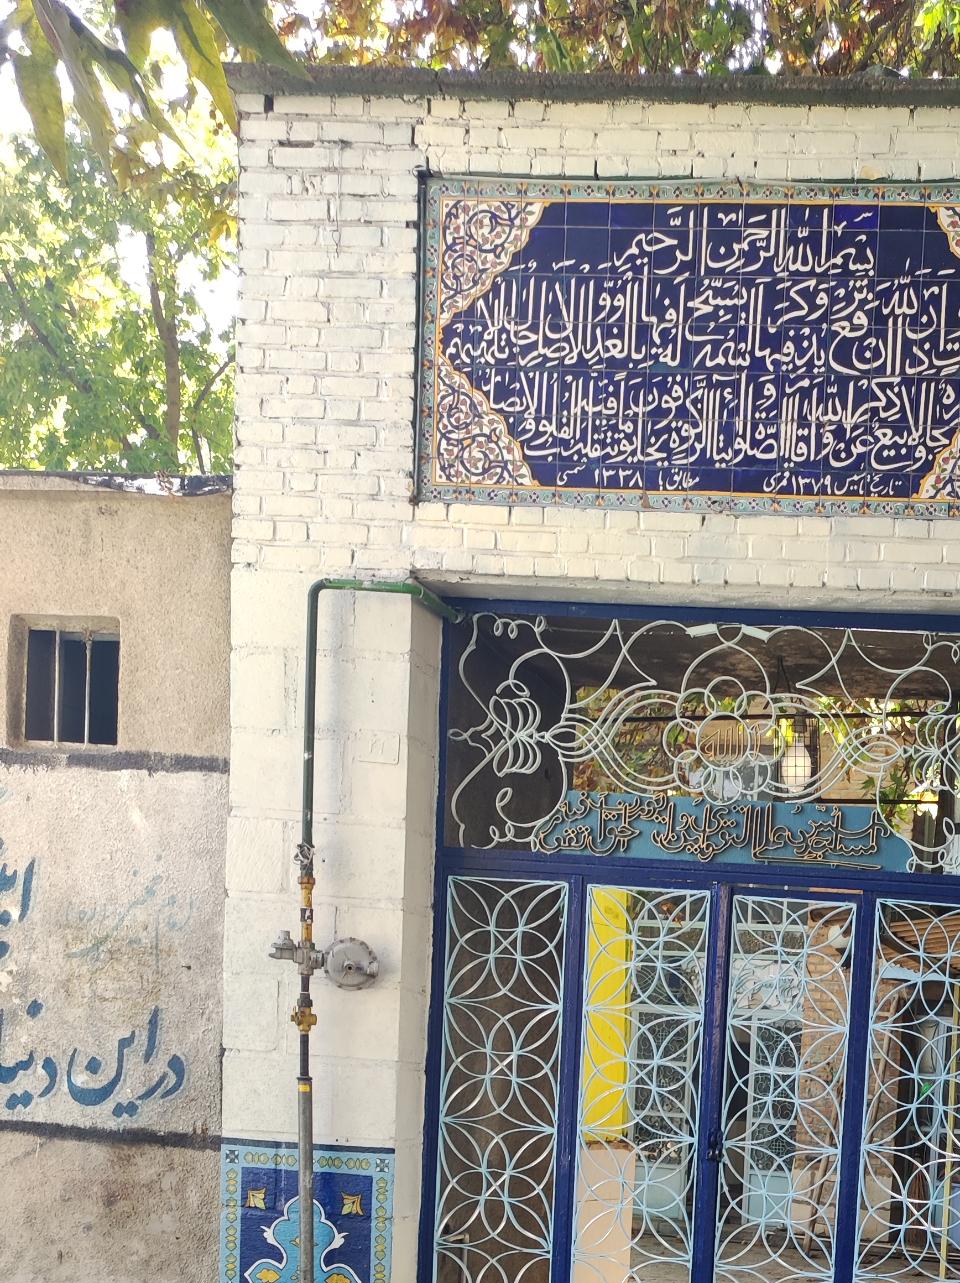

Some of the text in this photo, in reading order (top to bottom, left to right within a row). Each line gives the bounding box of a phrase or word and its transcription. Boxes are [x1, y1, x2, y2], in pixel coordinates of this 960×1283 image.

[556, 459, 587, 486] شمسی
[594, 469, 643, 488] ۱۳۳۸
[658, 470, 665, 491] با
[665, 467, 700, 490] مطابق
[763, 471, 790, 493] قمری
[792, 474, 832, 494] ۱۳۷۹
[870, 473, 902, 497] تاریخ
[67, 1005, 159, 1118] این
[133, 1054, 185, 1101] در
